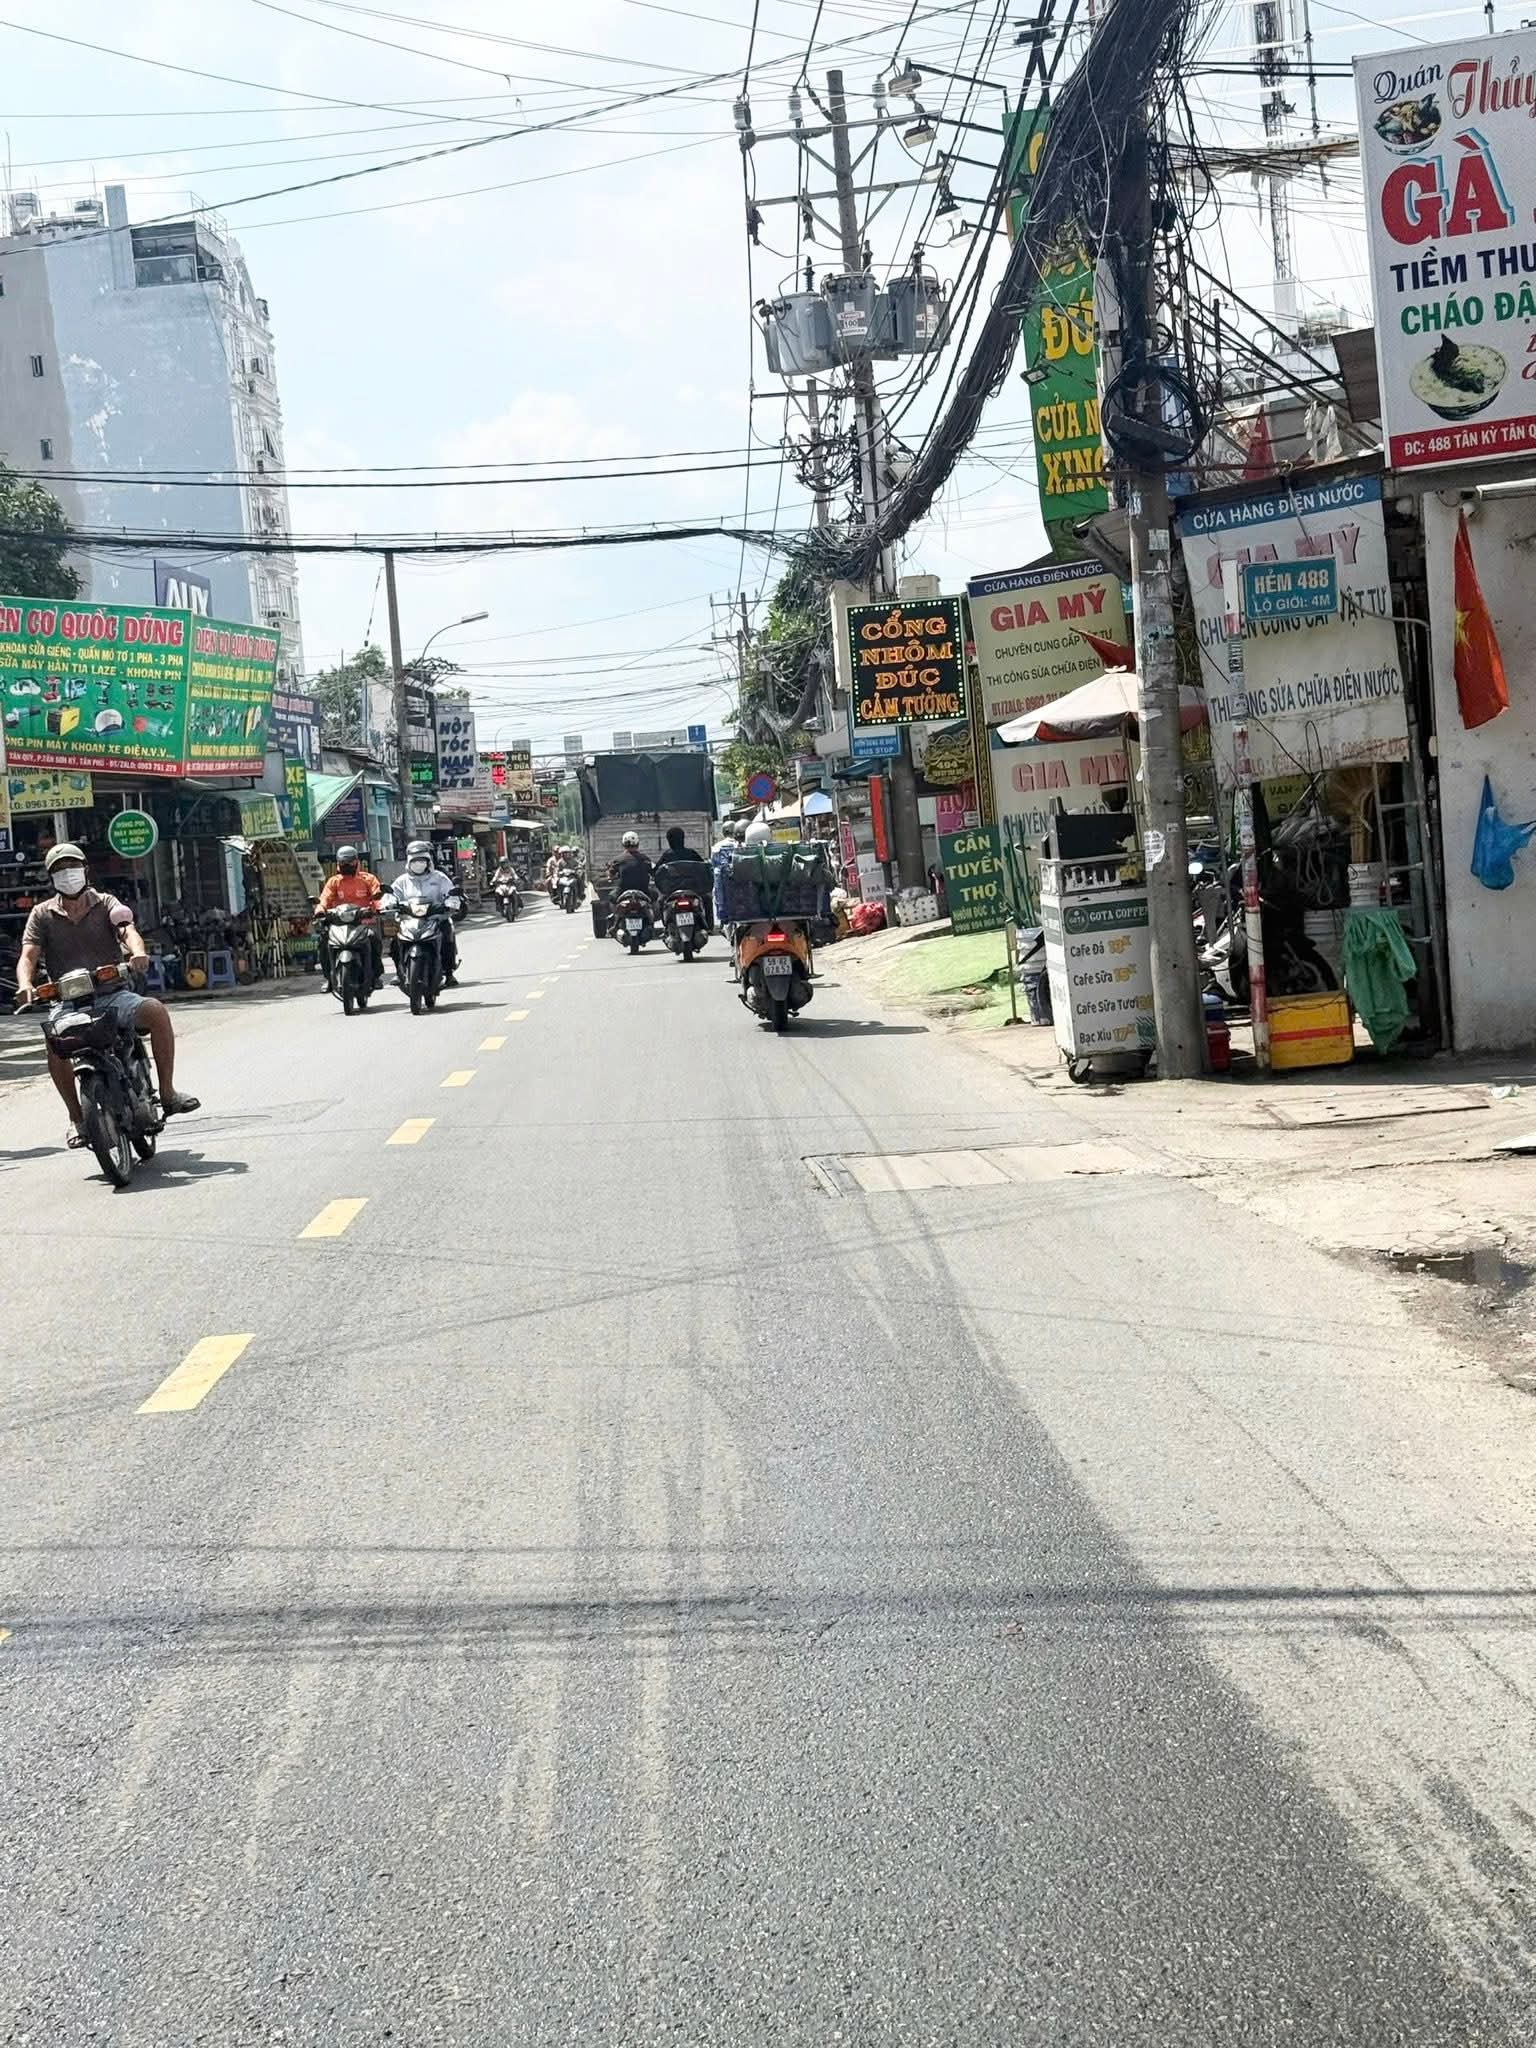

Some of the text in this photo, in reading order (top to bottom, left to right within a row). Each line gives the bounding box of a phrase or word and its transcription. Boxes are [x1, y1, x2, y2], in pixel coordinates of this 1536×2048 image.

[1373, 64, 1444, 104] Quán
[1381, 127, 1515, 245] GÀ
[1390, 246, 1467, 292] TIỀM
[1401, 291, 1484, 335] CHÁO
[1036, 391, 1082, 442] CỬA
[1404, 442, 1425, 456] ĐC:
[1428, 436, 1451, 451] 488
[1455, 432, 1479, 448] TÂN
[1501, 423, 1525, 441] TÂN
[1193, 482, 1364, 529] CỬA HÀNG ĐIỆN NƯỚC
[984, 564, 1103, 593] CỬA HÀNG ĐIỆN NƯỚC
[1254, 568, 1329, 594] HẺM 488
[990, 583, 1106, 632] GIA MỸ
[1254, 597, 1273, 613] LỘ
[1311, 593, 1331, 606] 4M
[27, 606, 58, 637] CƠ
[61, 606, 119, 641] QUỐC
[124, 612, 184, 647] DŨNG
[861, 609, 947, 641] CỔNG
[136, 653, 153, 664] PHA
[167, 655, 184, 666] PHA
[859, 639, 953, 666] NHÔM
[995, 642, 1032, 660] CHUYÊN
[1034, 638, 1061, 654] CUNG
[1062, 632, 1080, 649] CẤP
[92, 665, 116, 676] LAZE
[127, 668, 161, 679] KHOAN
[165, 671, 181, 681] PIN
[875, 664, 941, 690] ĐÚC
[987, 657, 1101, 687] THI CÔNG SỬA CHỮA ĐIỆN
[860, 692, 899, 719] CẢM
[1211, 696, 1232, 724] THI
[1269, 678, 1296, 713] SỬA
[1298, 672, 1332, 709] CHỮA
[1333, 667, 1361, 705] ĐIỆN
[1364, 662, 1399, 701] NƯỚC
[27, 739, 43, 749] PIN
[71, 742, 106, 753] KHOAN
[108, 745, 121, 754] XE
[440, 735, 469, 753] TÓC
[440, 754, 475, 770] NAM
[1012, 760, 1070, 792] GIA
[68, 797, 86, 806] 279
[954, 832, 991, 854] CẦN
[945, 851, 1006, 880] TUYỂN
[960, 880, 998, 903] THỢ
[1090, 910, 1113, 922] GOTA
[1070, 941, 1105, 958] Cafe Đá
[1073, 974, 1096, 986] Cafe
[1096, 970, 1113, 984] Sữa
[1076, 1002, 1097, 1015] Cafe
[1098, 999, 1116, 1012] Sữa
[1079, 1031, 1095, 1047] Bạc
